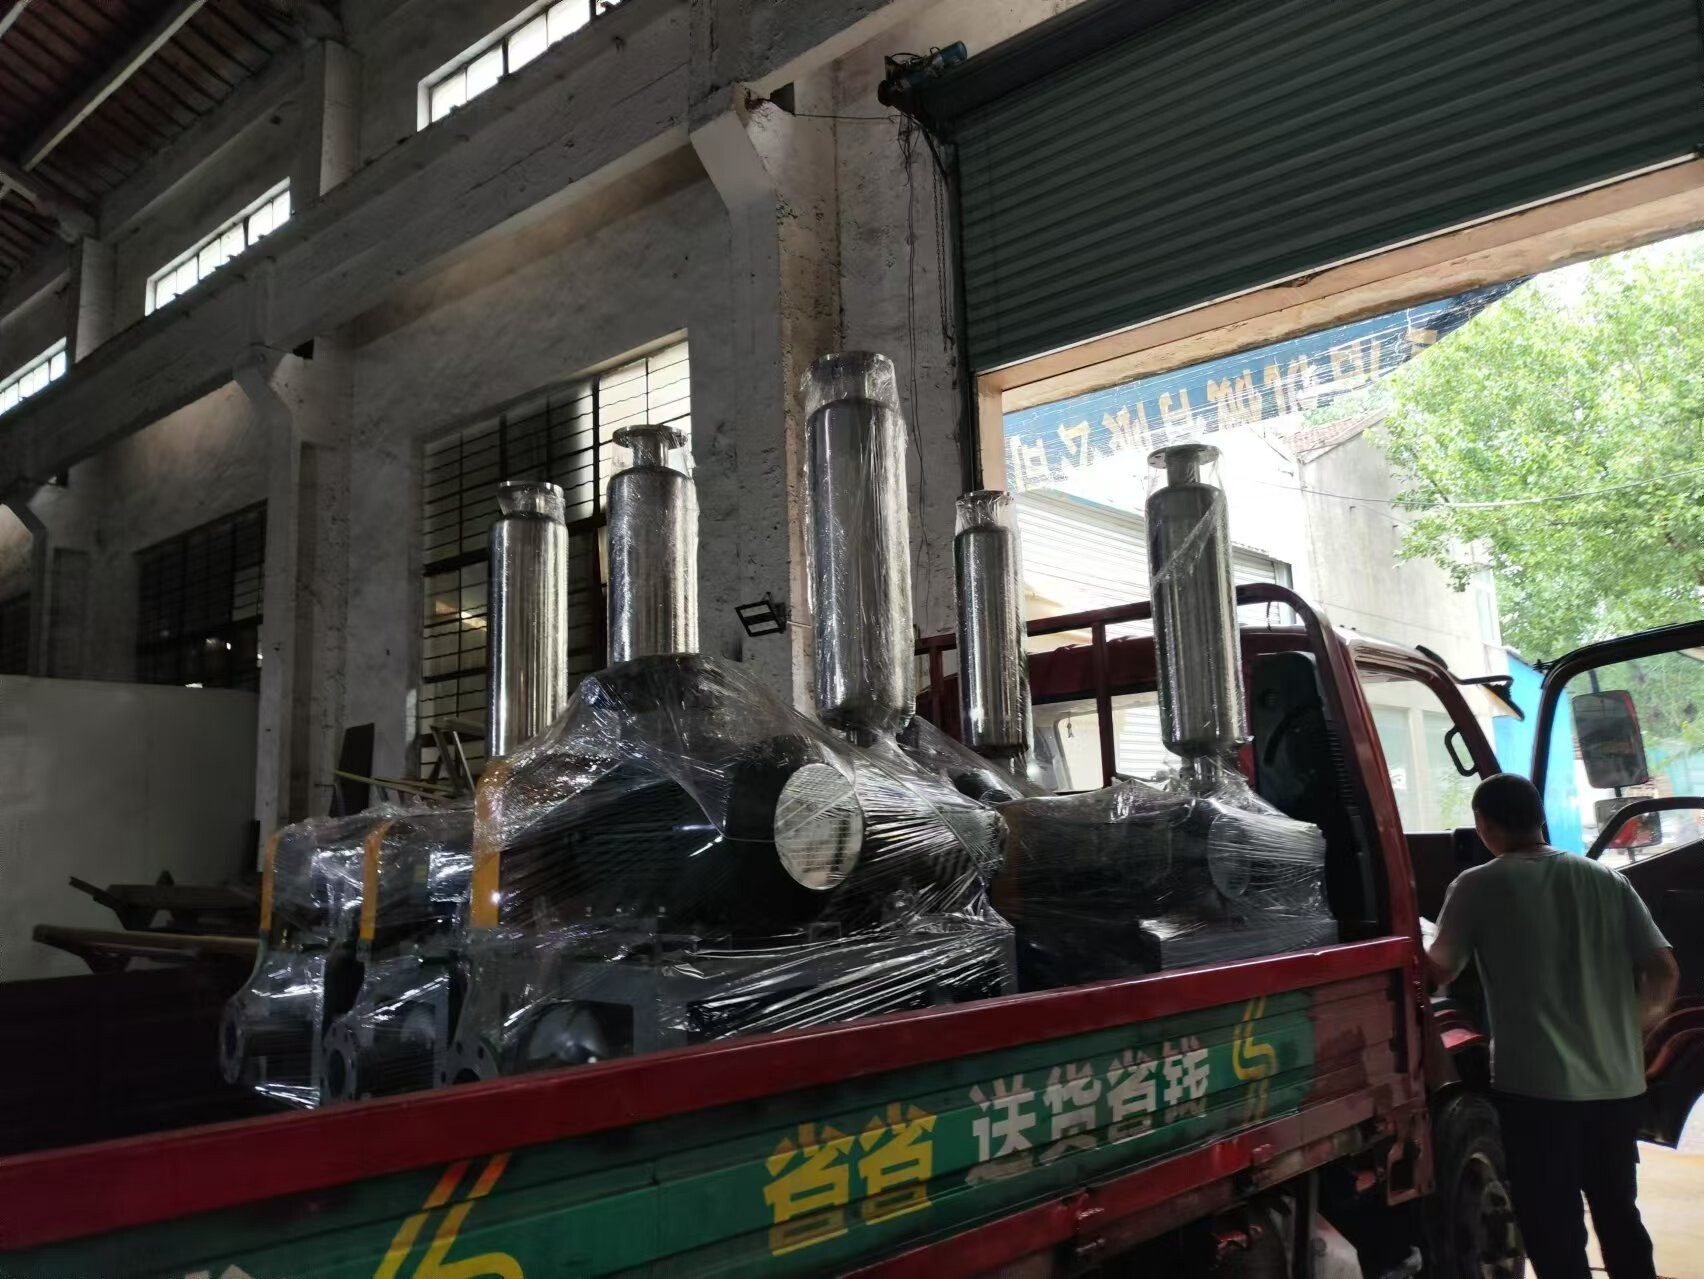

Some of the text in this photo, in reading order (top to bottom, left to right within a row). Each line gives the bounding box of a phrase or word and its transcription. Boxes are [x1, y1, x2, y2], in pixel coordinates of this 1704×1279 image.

[763, 1037, 1209, 1257] 省省 送货省钱
